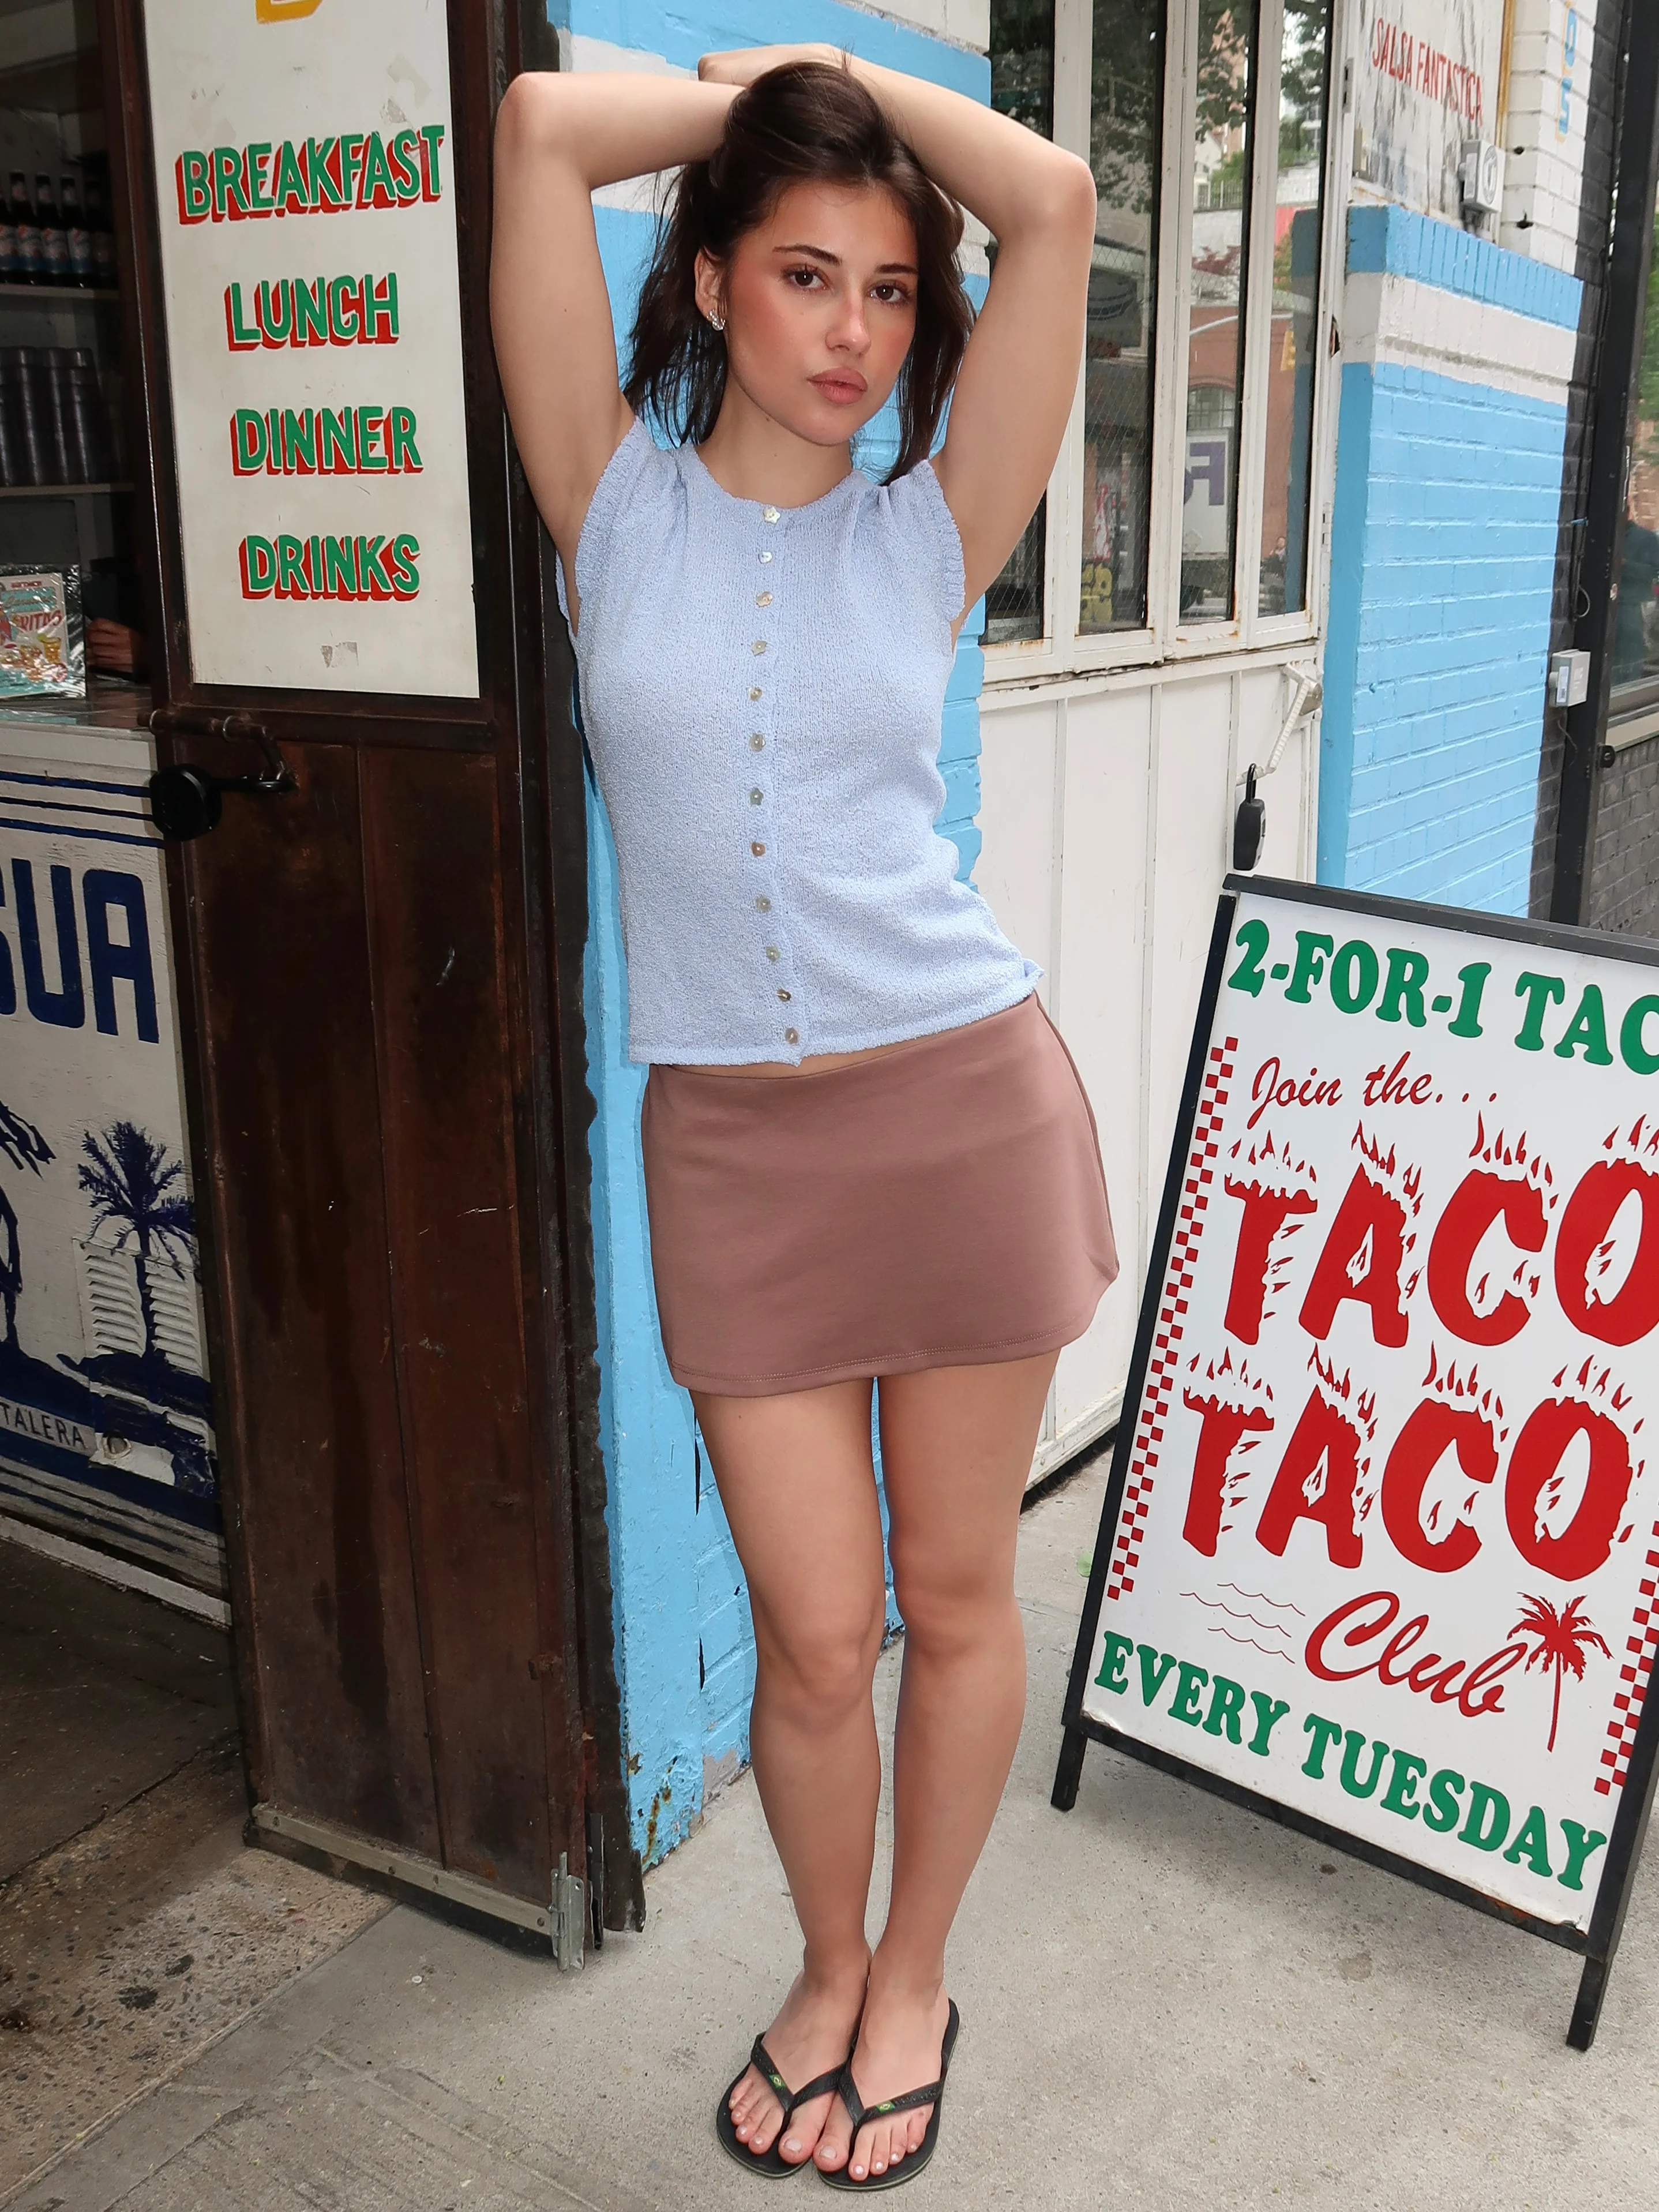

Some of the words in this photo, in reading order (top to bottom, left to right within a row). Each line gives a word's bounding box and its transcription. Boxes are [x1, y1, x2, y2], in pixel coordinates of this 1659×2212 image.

[1372, 17, 1413, 88] SALSA
[1415, 40, 1483, 128] FANTASTICA
[175, 125, 445, 225] BREAKFAST
[224, 272, 399, 351] LUNCH
[230, 406, 423, 476] DINNER
[238, 534, 420, 602] DRINKS
[0, 858, 159, 1044] UA
[1227, 919, 1492, 1038] 2-FOR-1
[1247, 1056, 1342, 1130] Join
[1224, 1157, 1659, 1348] TACO
[0, 1402, 87, 1449] TALERA
[1183, 1385, 1634, 1582] TACO
[1304, 1591, 1529, 1718] Club
[1094, 1630, 1290, 1757] EVERY
[1301, 1714, 1607, 1891] TUESDAY
